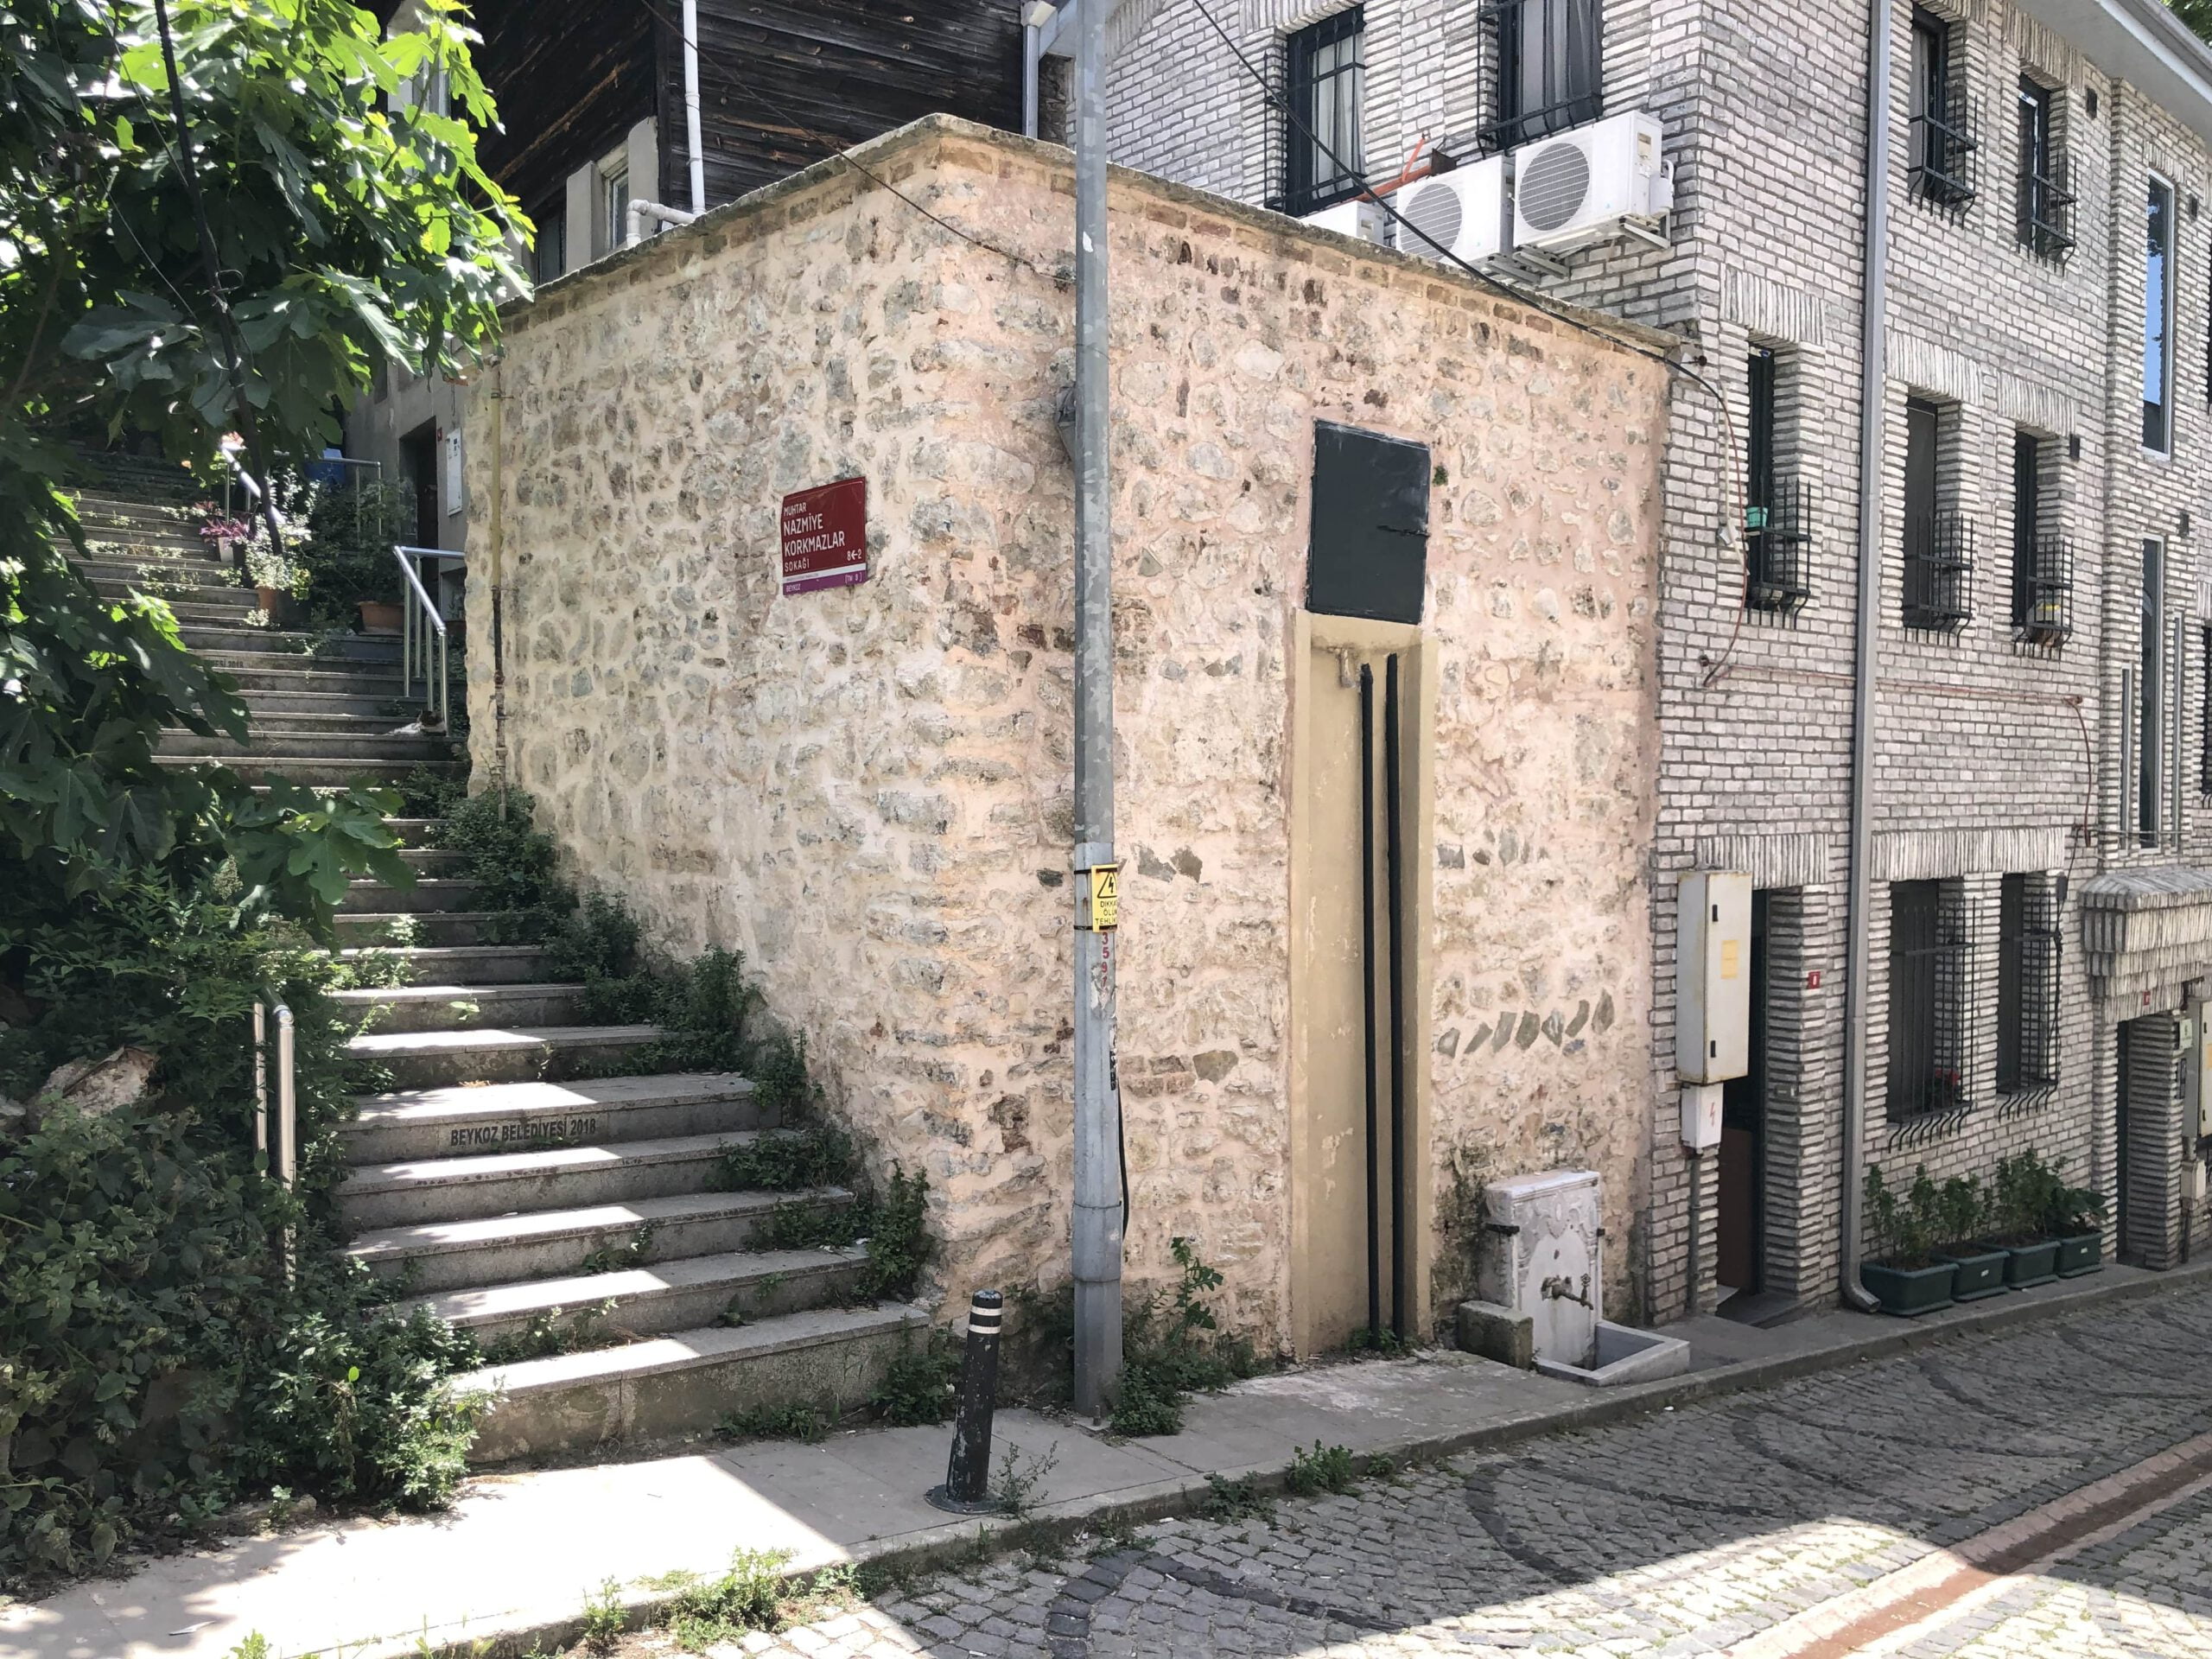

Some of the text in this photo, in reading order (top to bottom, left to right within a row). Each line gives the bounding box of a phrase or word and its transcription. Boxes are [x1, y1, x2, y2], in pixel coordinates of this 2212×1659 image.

[784, 502, 807, 517] MUHTAR
[784, 512, 823, 537] NAZMİYE
[785, 531, 845, 557] KORKMAZLAR
[785, 557, 810, 572] SOKAĞI
[451, 1117, 596, 1146] BEYKOZ BELEDİYESİ 2018
